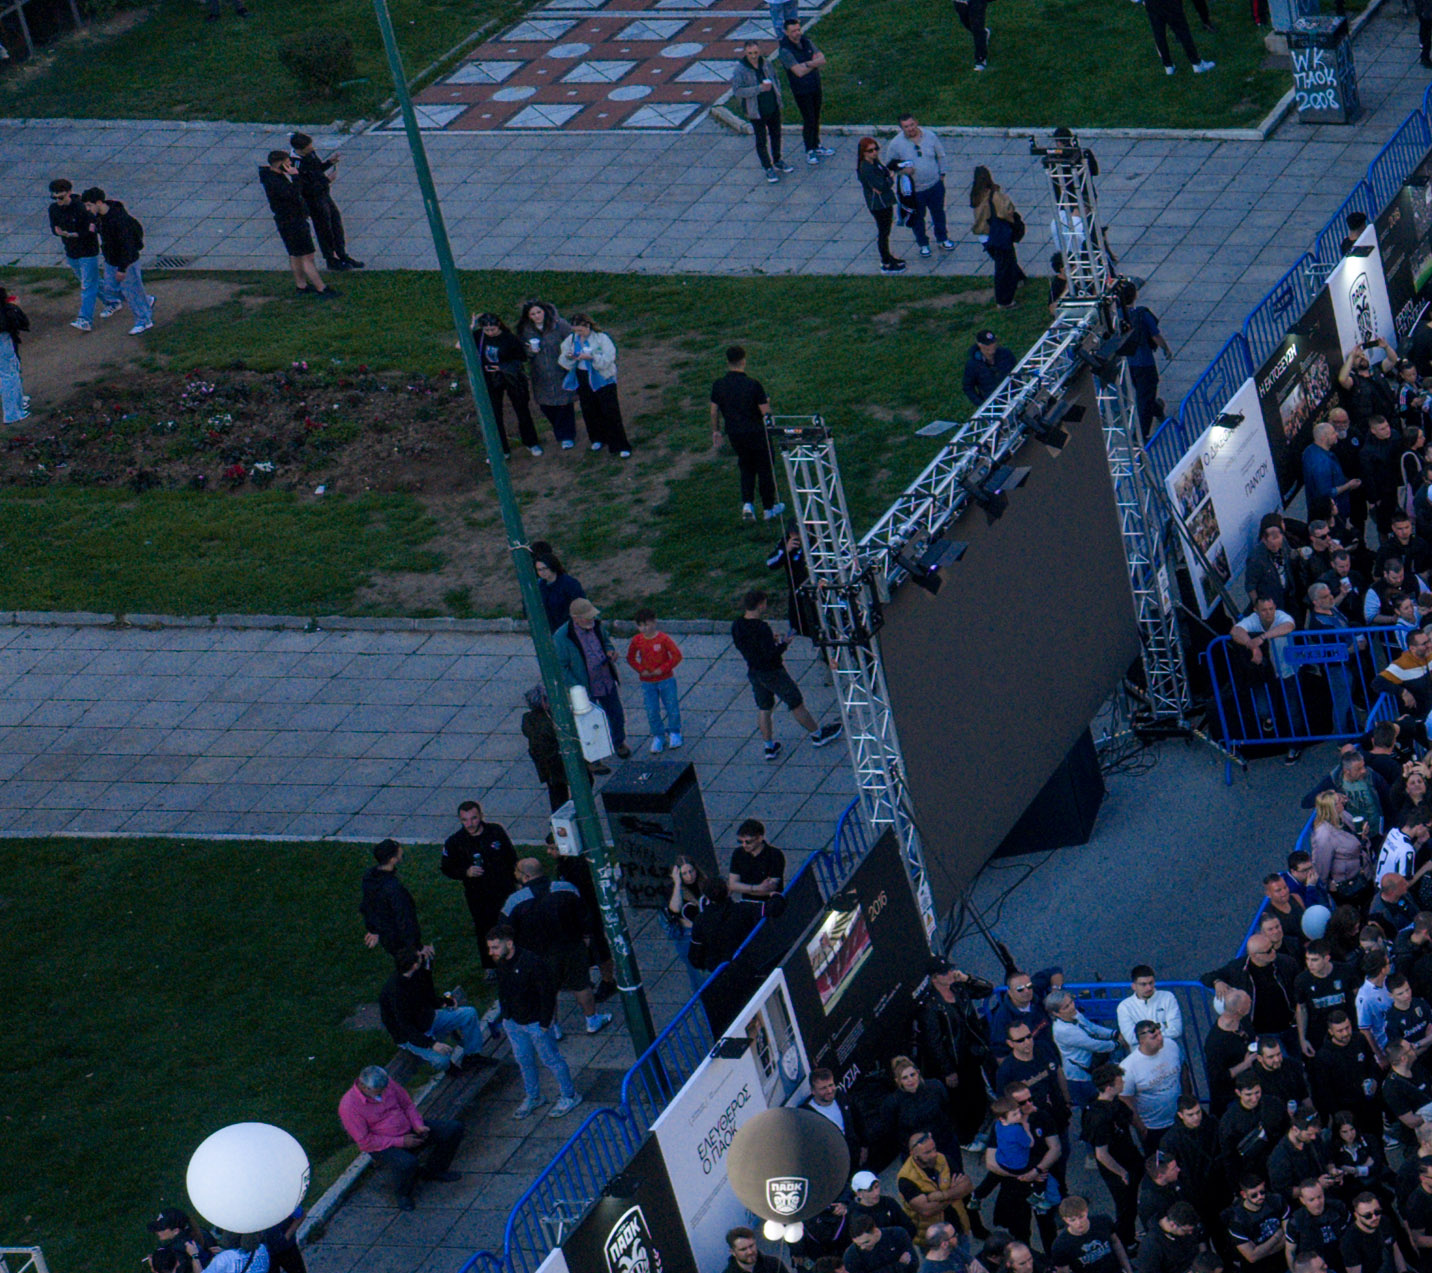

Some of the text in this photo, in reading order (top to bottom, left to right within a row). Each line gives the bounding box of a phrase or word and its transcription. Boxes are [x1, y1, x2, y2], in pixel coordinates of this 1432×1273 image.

[1296, 89, 1340, 112] 2008
[868, 890, 888, 923] 2016
[697, 1083, 752, 1162] ΕΛΕΥΘΕΡΟΣ
[702, 1160, 712, 1176] Ο
[771, 1183, 802, 1192] ΠΑΟΚ
[609, 1216, 641, 1264] ΠΑΟΚ
